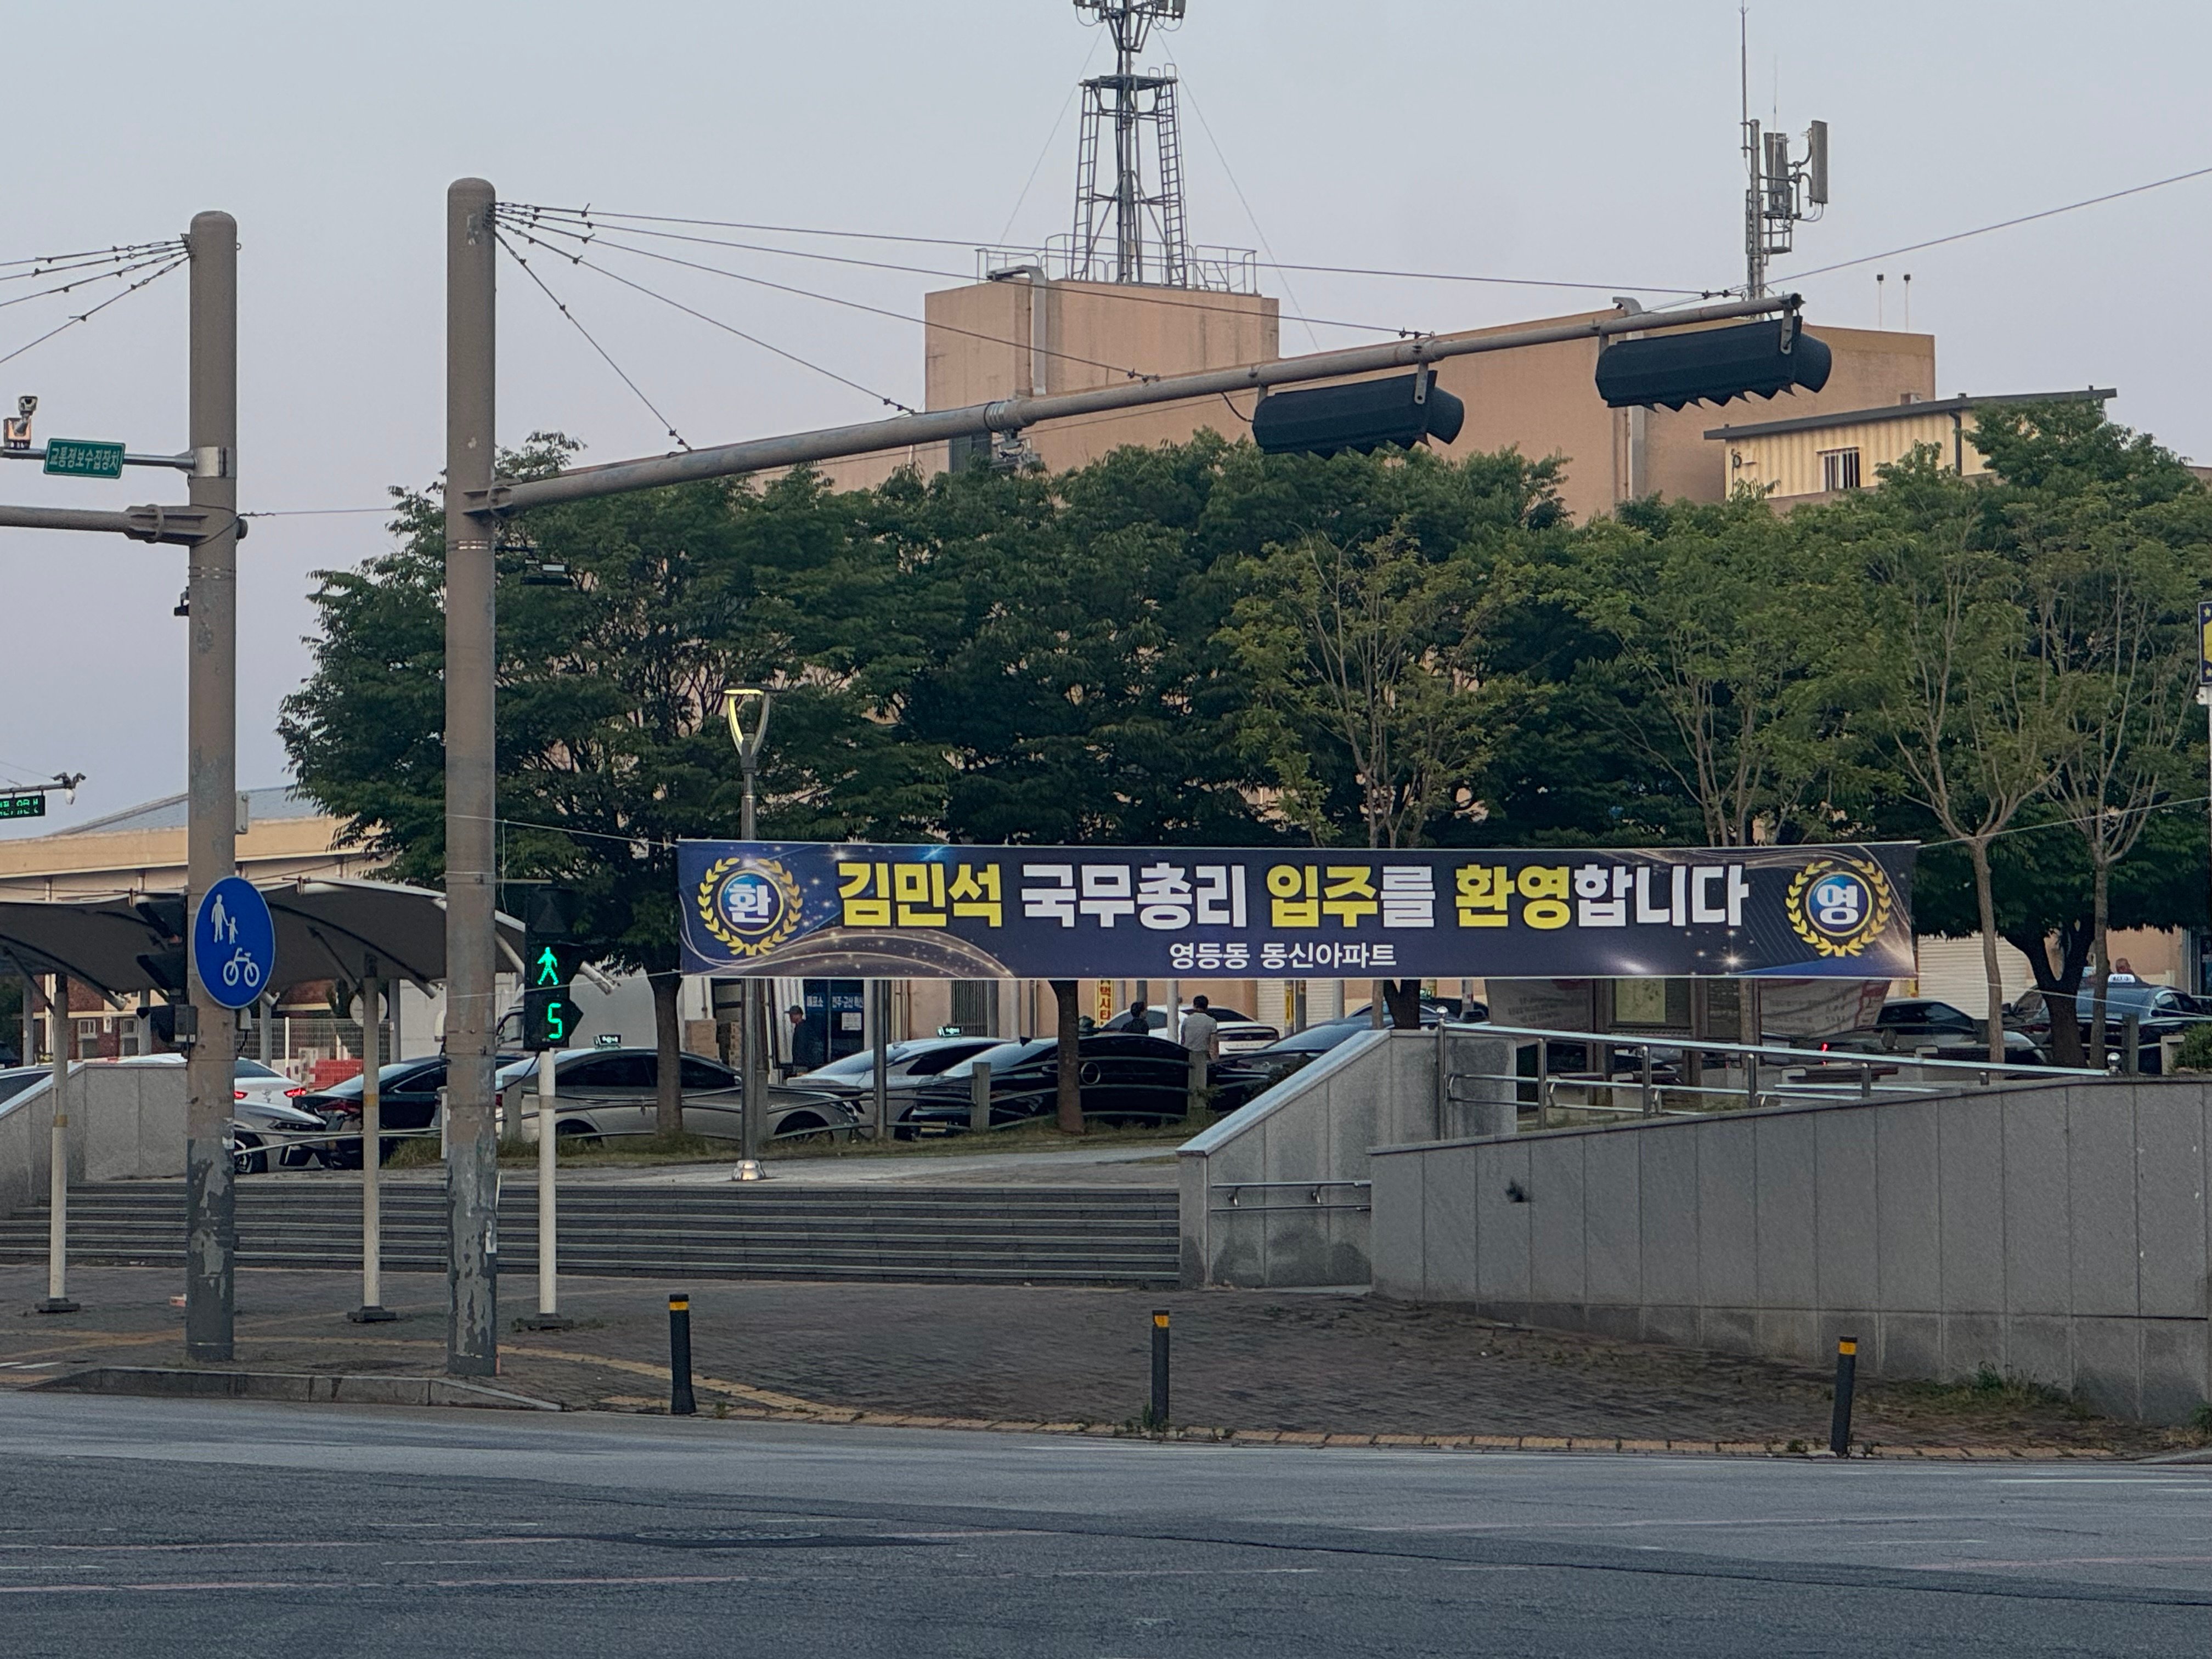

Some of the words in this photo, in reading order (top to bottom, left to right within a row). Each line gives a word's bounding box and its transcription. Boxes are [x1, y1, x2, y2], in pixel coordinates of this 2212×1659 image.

[49, 446, 120, 471] 교통정보수집장치
[728, 883, 771, 923] 환
[837, 862, 1002, 927] 김민석
[1022, 862, 1247, 929] 국무총리
[1267, 864, 1436, 928] 입주를
[1455, 864, 1750, 929] 환영합니다
[1817, 885, 1859, 925] 영
[1170, 942, 1250, 969] 영등동
[1260, 942, 1397, 969] 동신아파트
[548, 1003, 562, 1039] 5
